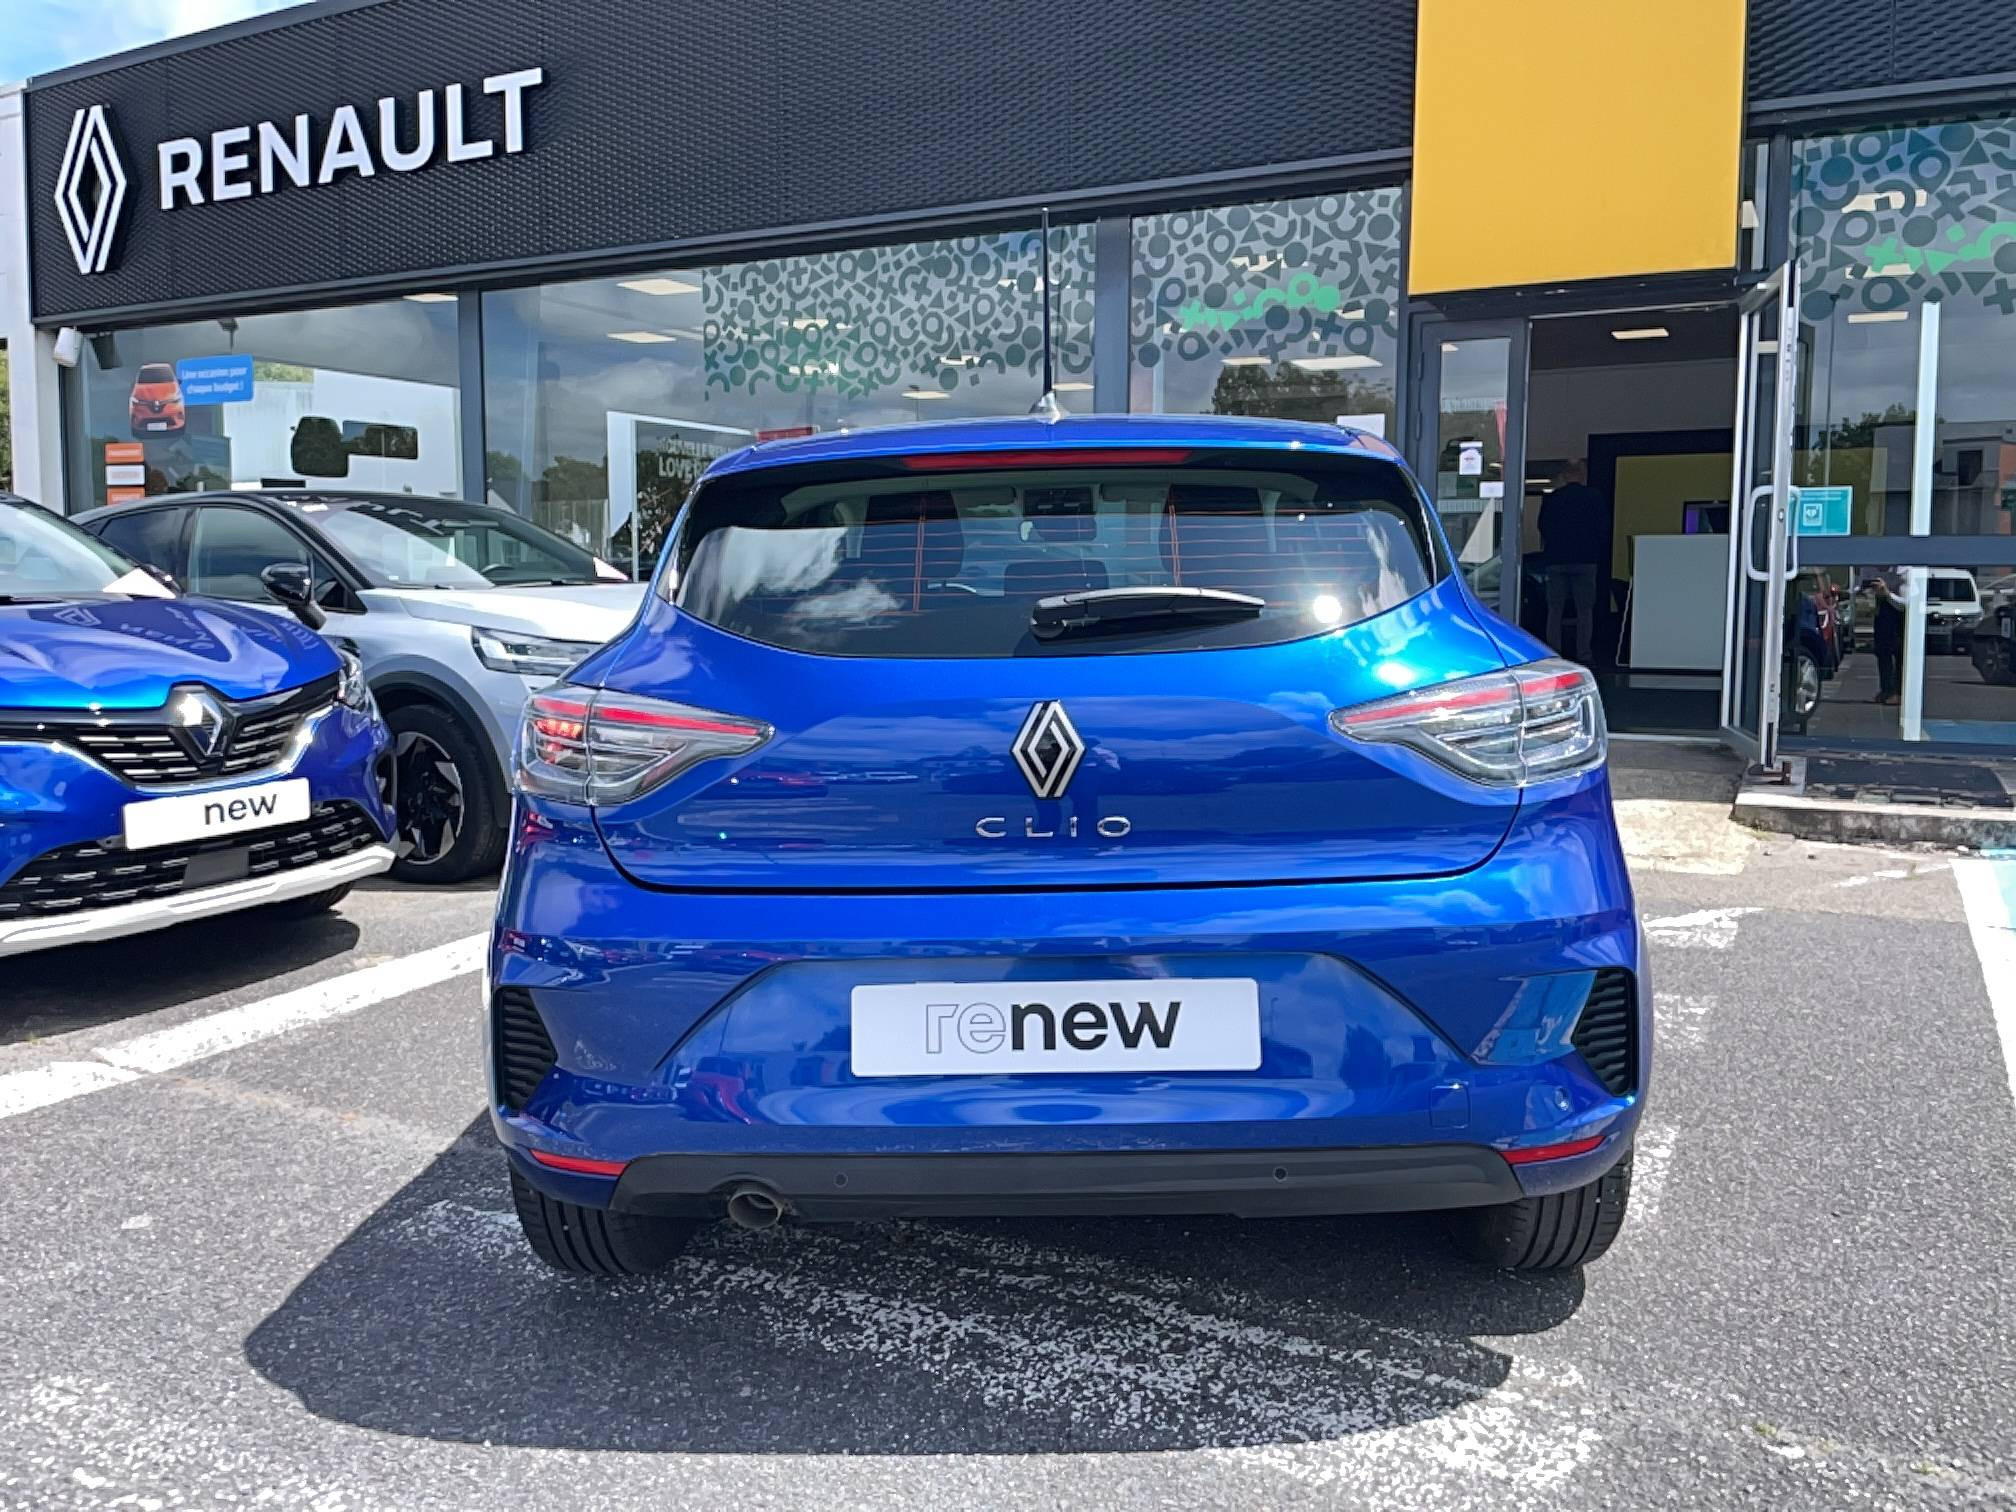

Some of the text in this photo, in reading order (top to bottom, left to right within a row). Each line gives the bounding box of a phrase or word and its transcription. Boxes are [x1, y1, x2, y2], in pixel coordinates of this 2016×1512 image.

[157, 67, 543, 211] RENAULT
[204, 794, 278, 825] new
[976, 816, 1131, 838] CLIO
[925, 1001, 1182, 1054] renew
